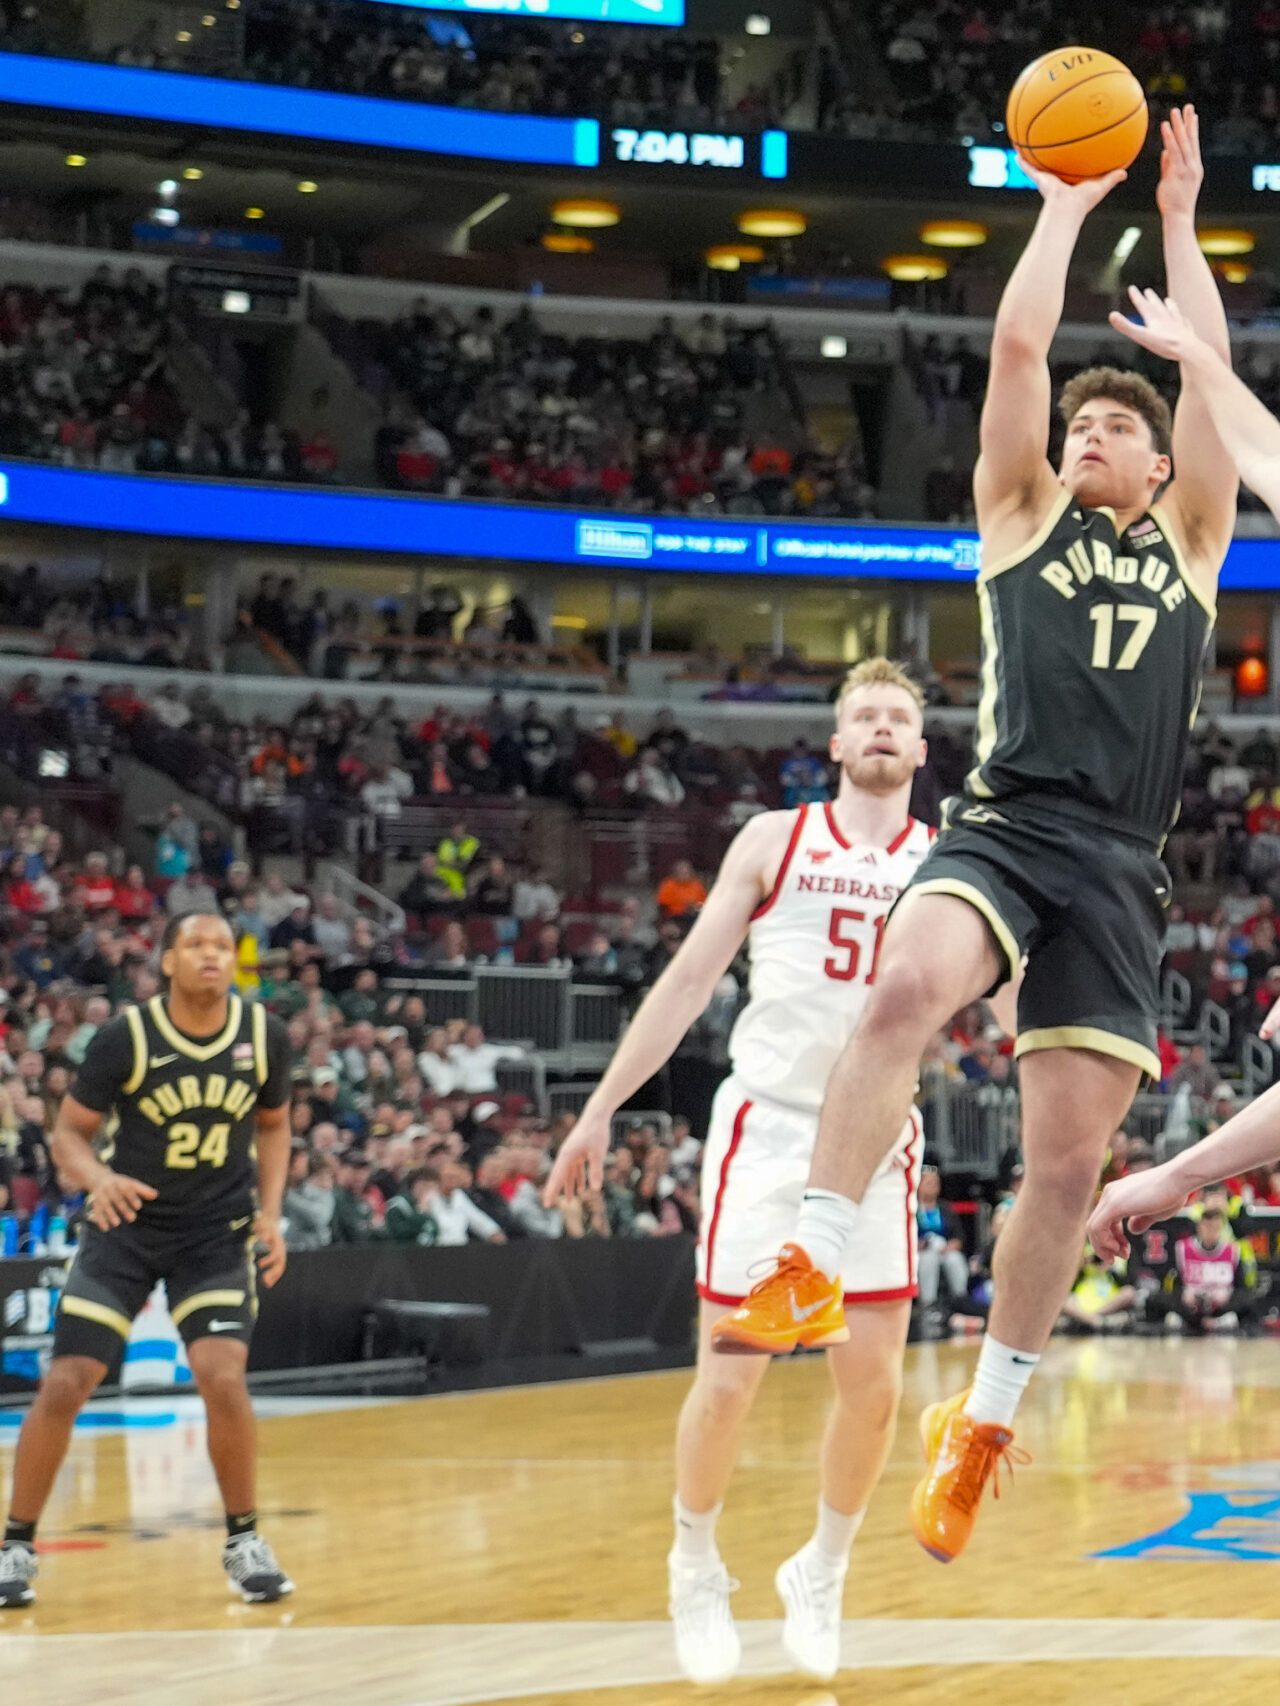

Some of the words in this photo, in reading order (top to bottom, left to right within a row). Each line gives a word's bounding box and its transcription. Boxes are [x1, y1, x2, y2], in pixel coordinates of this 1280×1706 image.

[611, 129, 688, 164] 7:04
[690, 133, 744, 168] PM
[1039, 539, 1187, 612] PURDUE
[1089, 603, 1158, 670] 17
[824, 908, 886, 985] 51
[165, 1122, 231, 1170] 24
